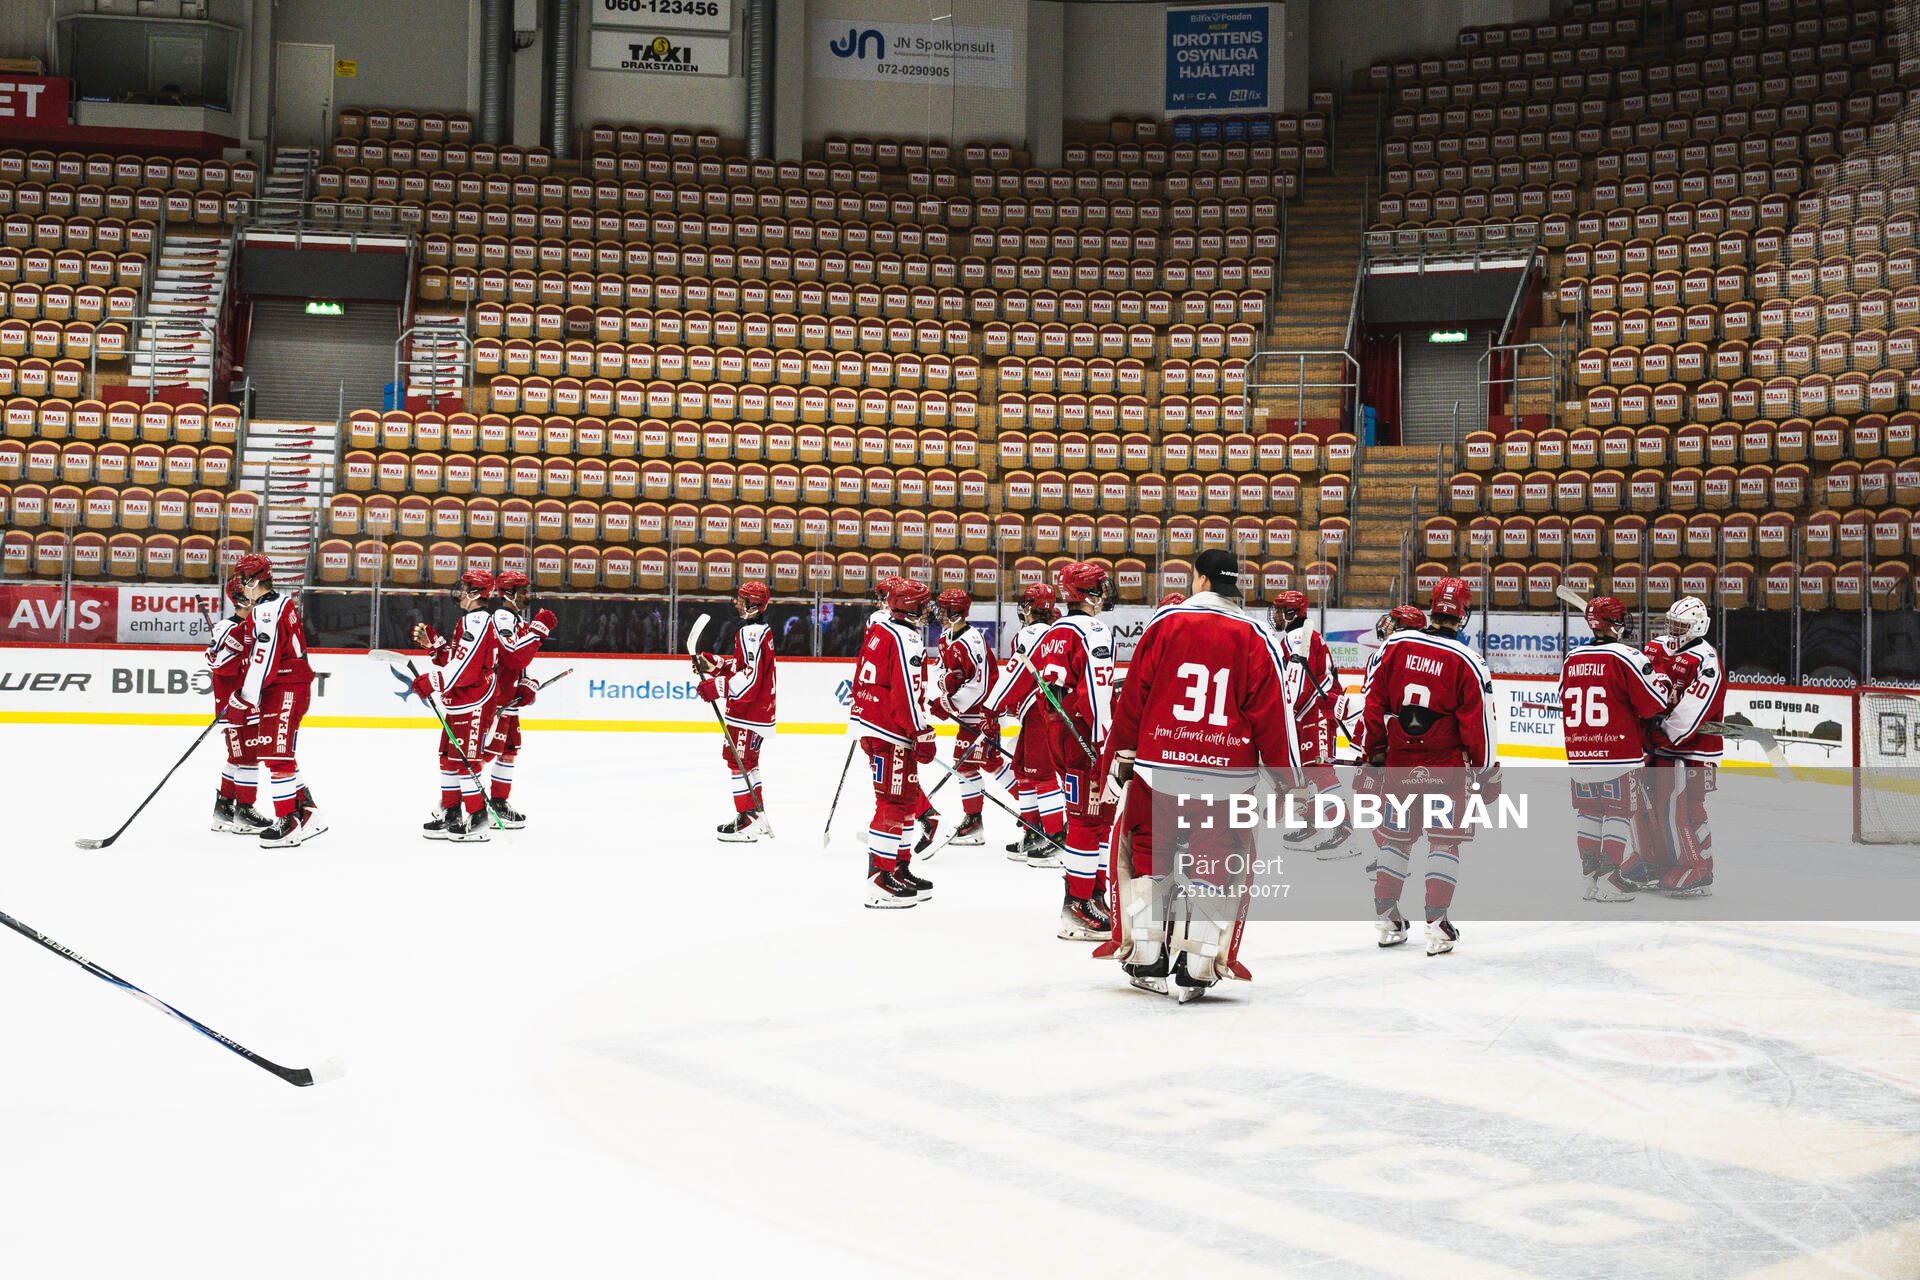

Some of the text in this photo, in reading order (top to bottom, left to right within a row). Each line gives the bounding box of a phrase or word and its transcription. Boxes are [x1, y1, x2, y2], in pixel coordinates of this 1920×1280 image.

[605, 0, 719, 16] 060-123456
[893, 37, 995, 54] JN Spolkonsult
[1172, 31, 1263, 47] IDROTTENS
[629, 43, 692, 64] TAXI
[1176, 47, 1259, 63] OSYNLIGA
[621, 61, 699, 73] DRAKSTADEN
[877, 63, 950, 77] 072-0290905
[1179, 62, 1255, 79] HJÄLTAR!
[1707, 484, 1726, 492] MAXI
[1862, 478, 1881, 486] MAXI
[1761, 531, 1782, 539] MAXI
[1649, 582, 1668, 590] MAXI
[1768, 582, 1787, 590] MAXI
[7, 599, 101, 631] AVIS
[130, 618, 185, 632] emhart
[1405, 654, 1444, 677] NEUMAN
[1172, 662, 1230, 727] 31
[1686, 680, 1710, 699] 30
[1510, 706, 1534, 718] DET
[1565, 686, 1609, 728] 36
[1775, 700, 1801, 713] Bygg
[1805, 703, 1820, 714] AB
[276, 691, 294, 753] PEAB
[1510, 721, 1555, 735] ENKELT
[1204, 732, 1225, 745] with
[1226, 733, 1241, 747] love
[1162, 750, 1230, 767] BILBOLAGET
